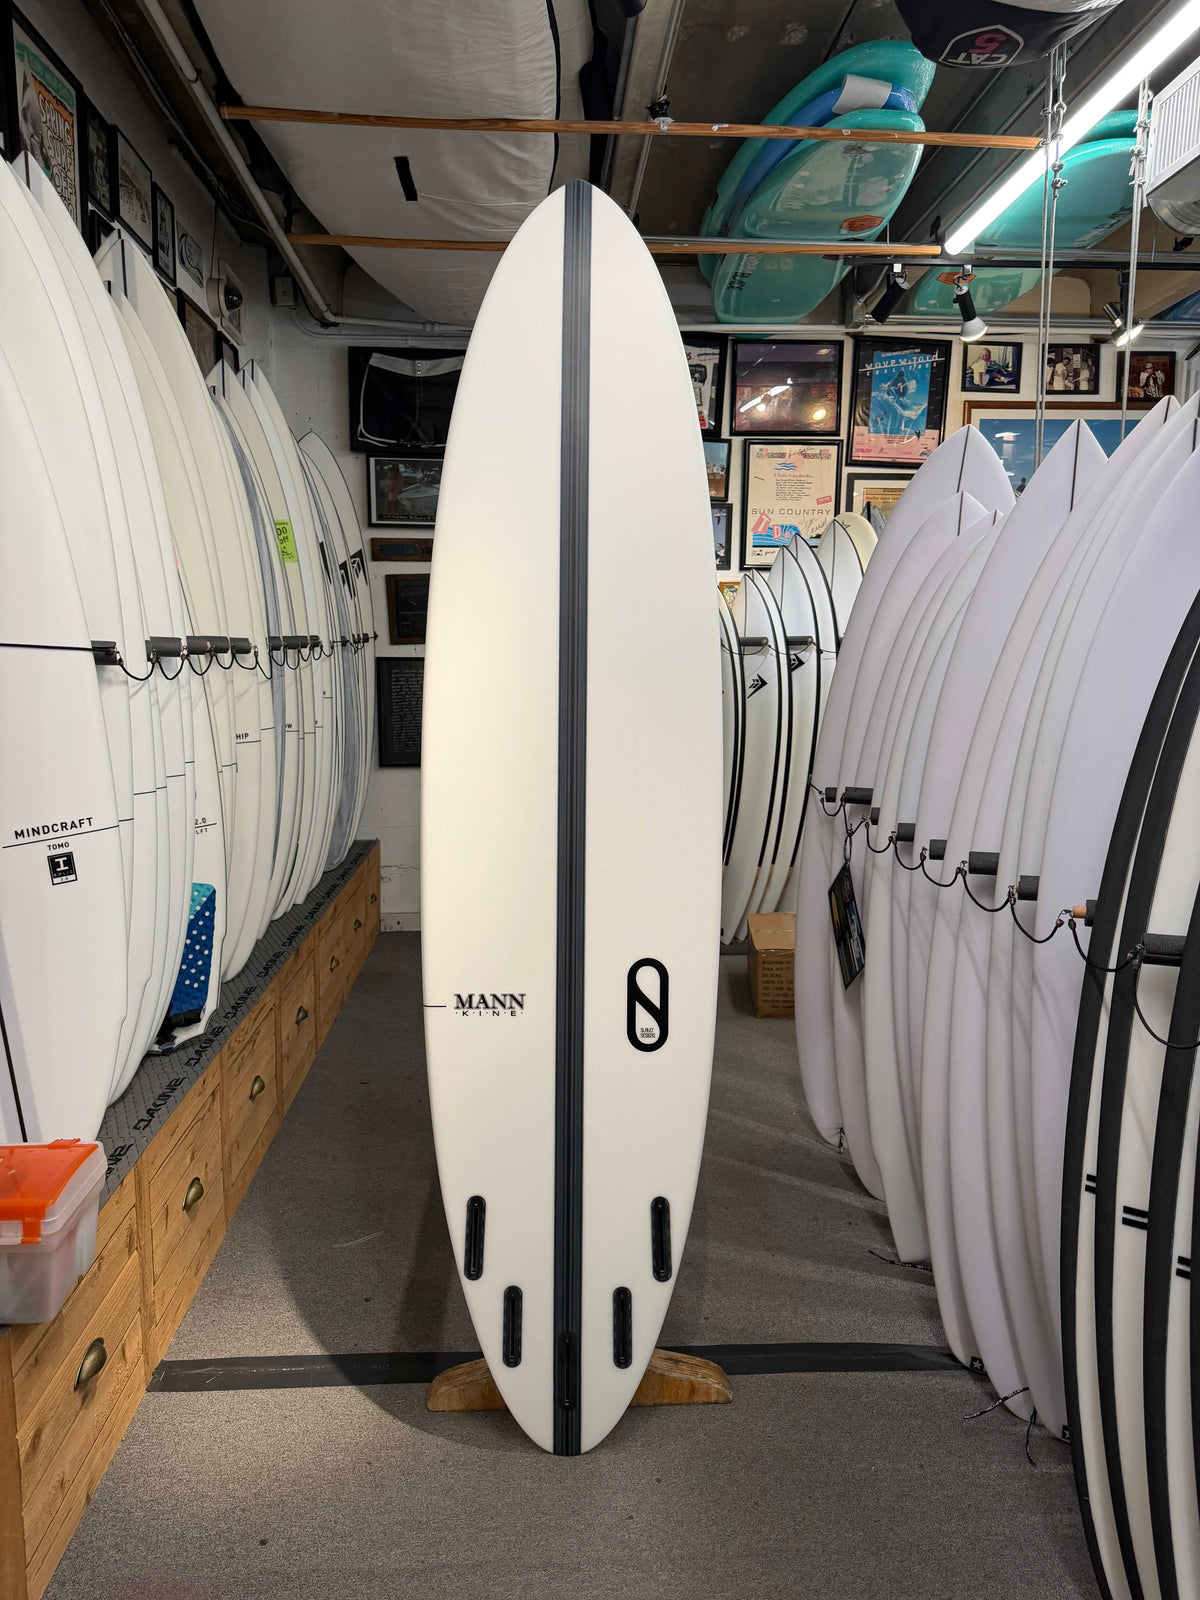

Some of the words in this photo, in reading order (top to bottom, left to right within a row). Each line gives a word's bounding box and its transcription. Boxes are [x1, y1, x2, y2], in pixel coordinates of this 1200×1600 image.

[968, 33, 1006, 54] 5
[948, 53, 1007, 65] CAT
[38, 90, 72, 145] SPRING
[14, 817, 93, 839] MINDCRAFT
[47, 842, 70, 850] TOMO
[454, 993, 526, 1010] MANN
[184, 1025, 227, 1067] DAKINE
[132, 1076, 187, 1131] DAKINE
